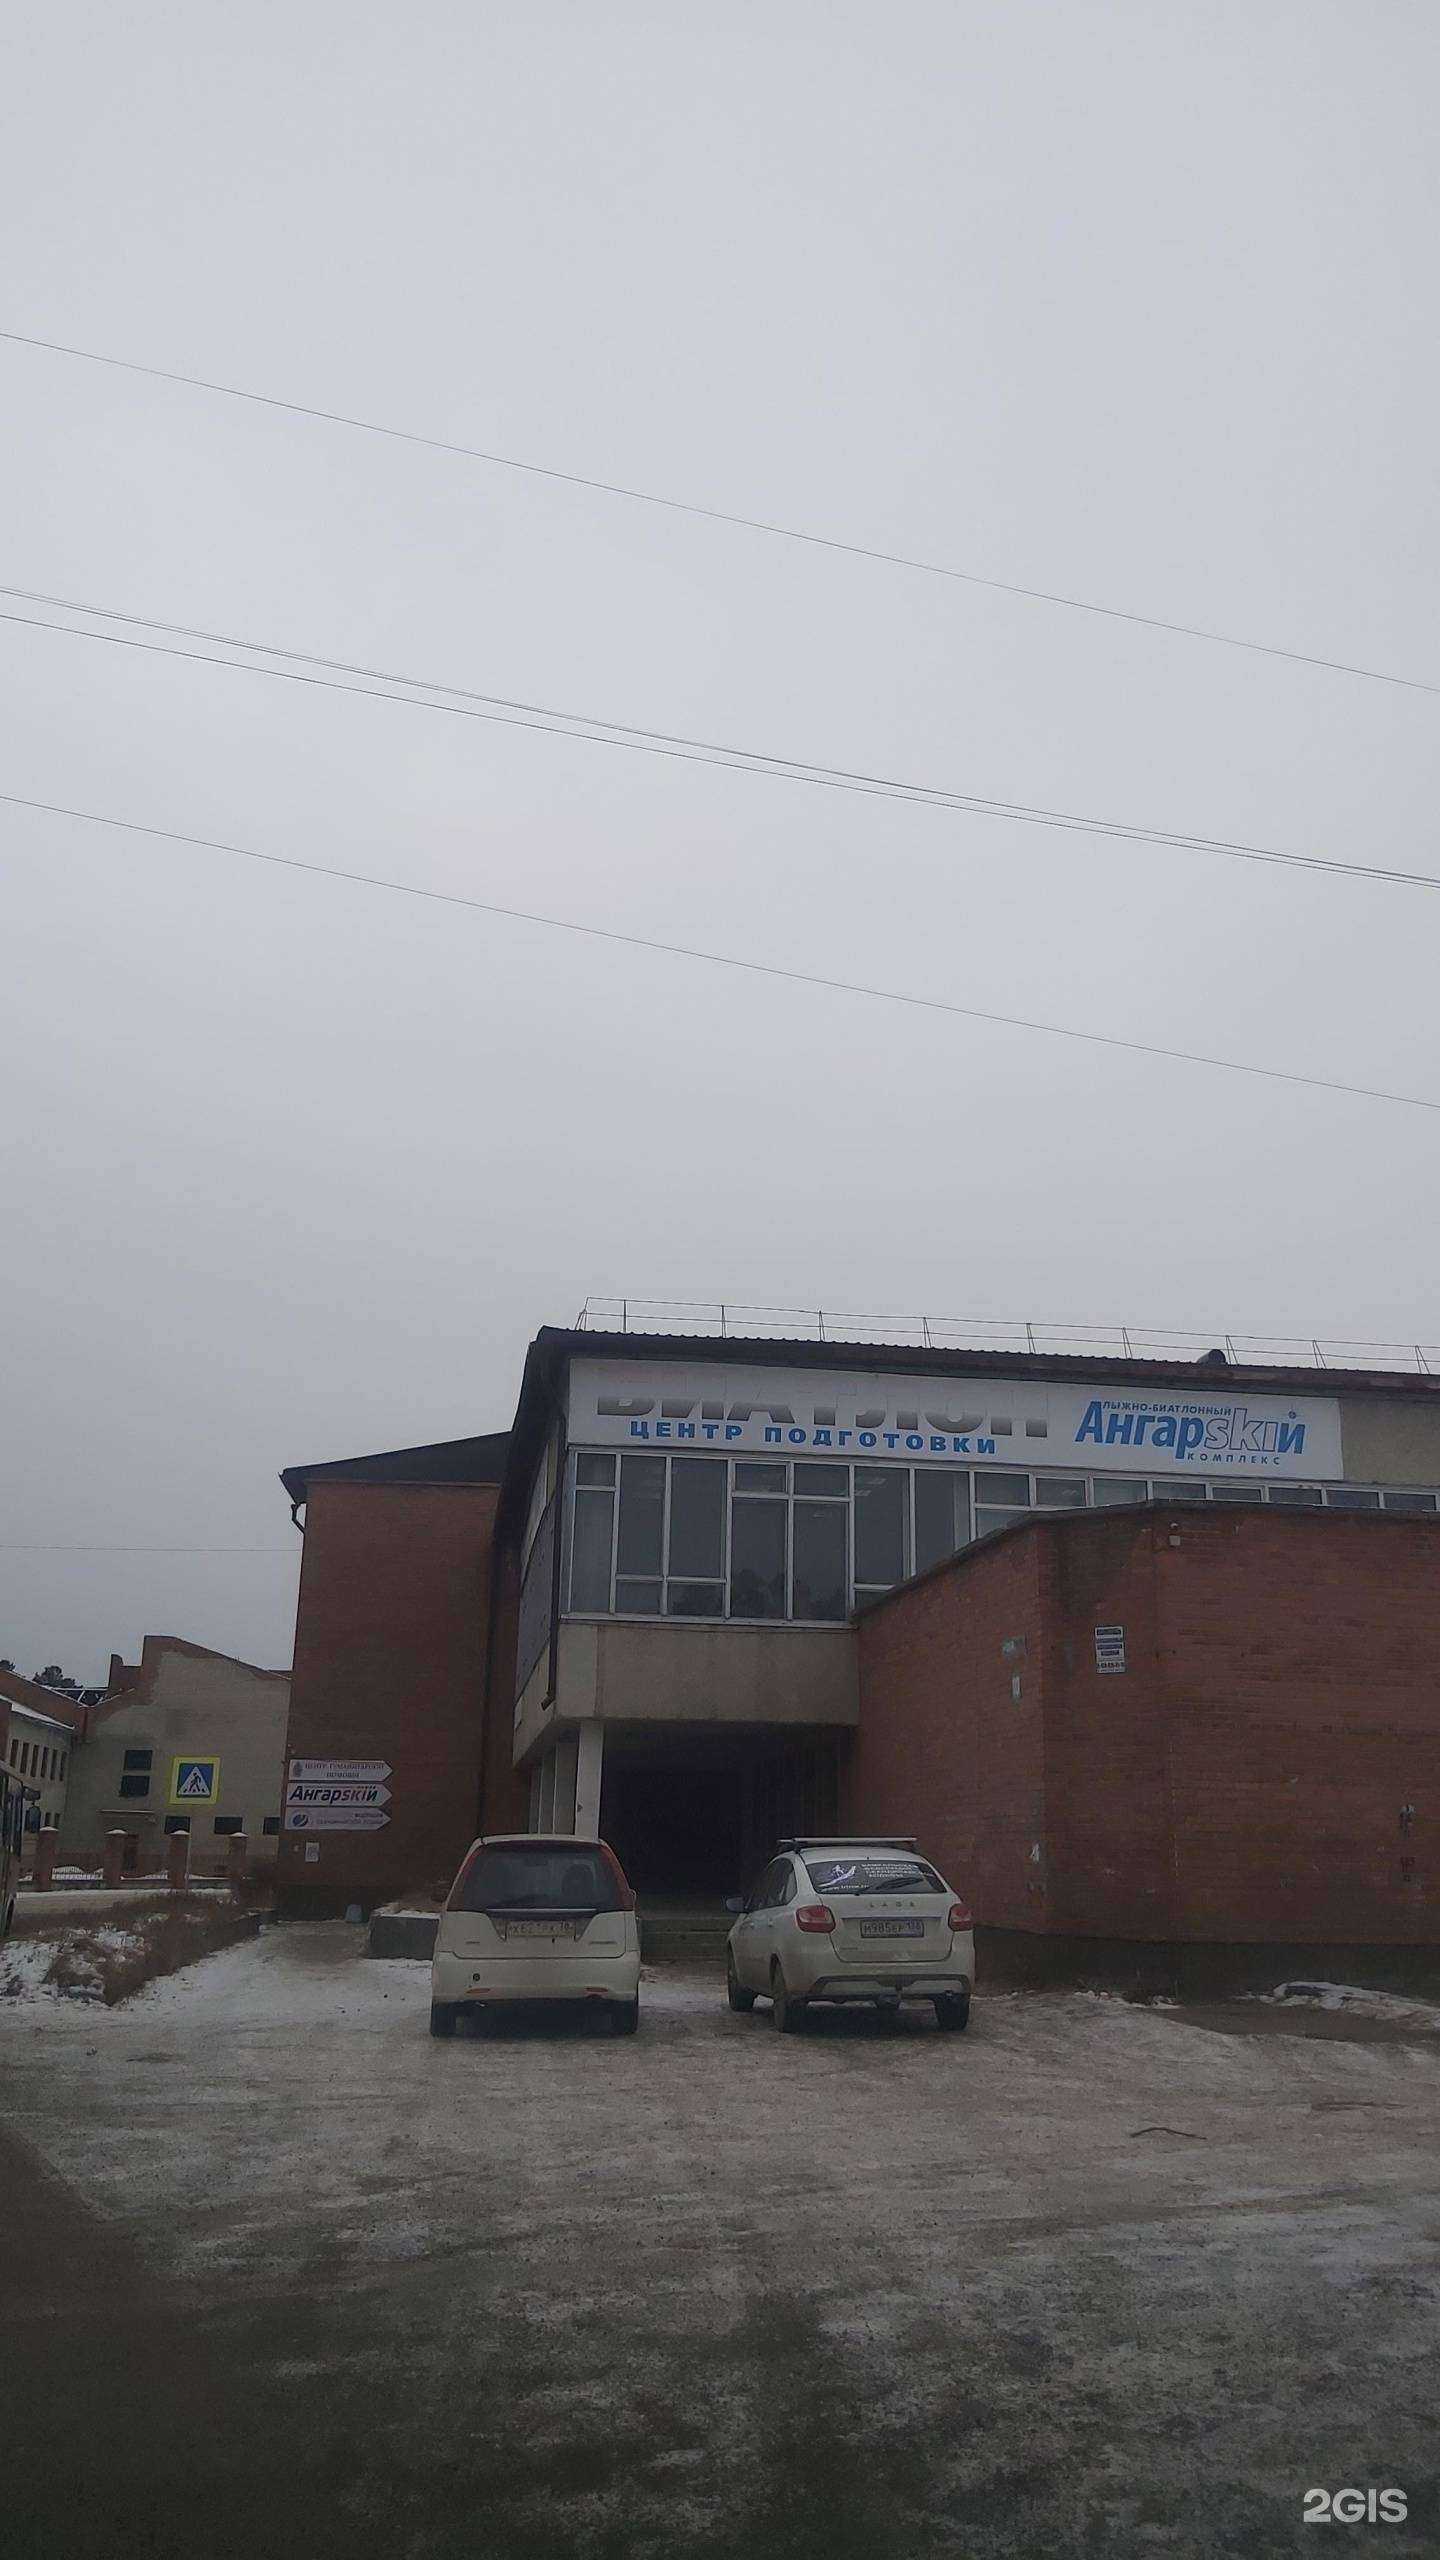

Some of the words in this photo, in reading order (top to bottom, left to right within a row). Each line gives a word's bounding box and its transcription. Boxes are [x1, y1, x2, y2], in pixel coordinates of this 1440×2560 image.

[1102, 1401, 1231, 1416] ЛЫЖНО-БИАТЛОННЫЙ
[629, 1421, 743, 1441] ЦЕНТР
[764, 1427, 996, 1454] ПОДГОТОВКИ
[1187, 1453, 1281, 1465] КОМПЛЕКС
